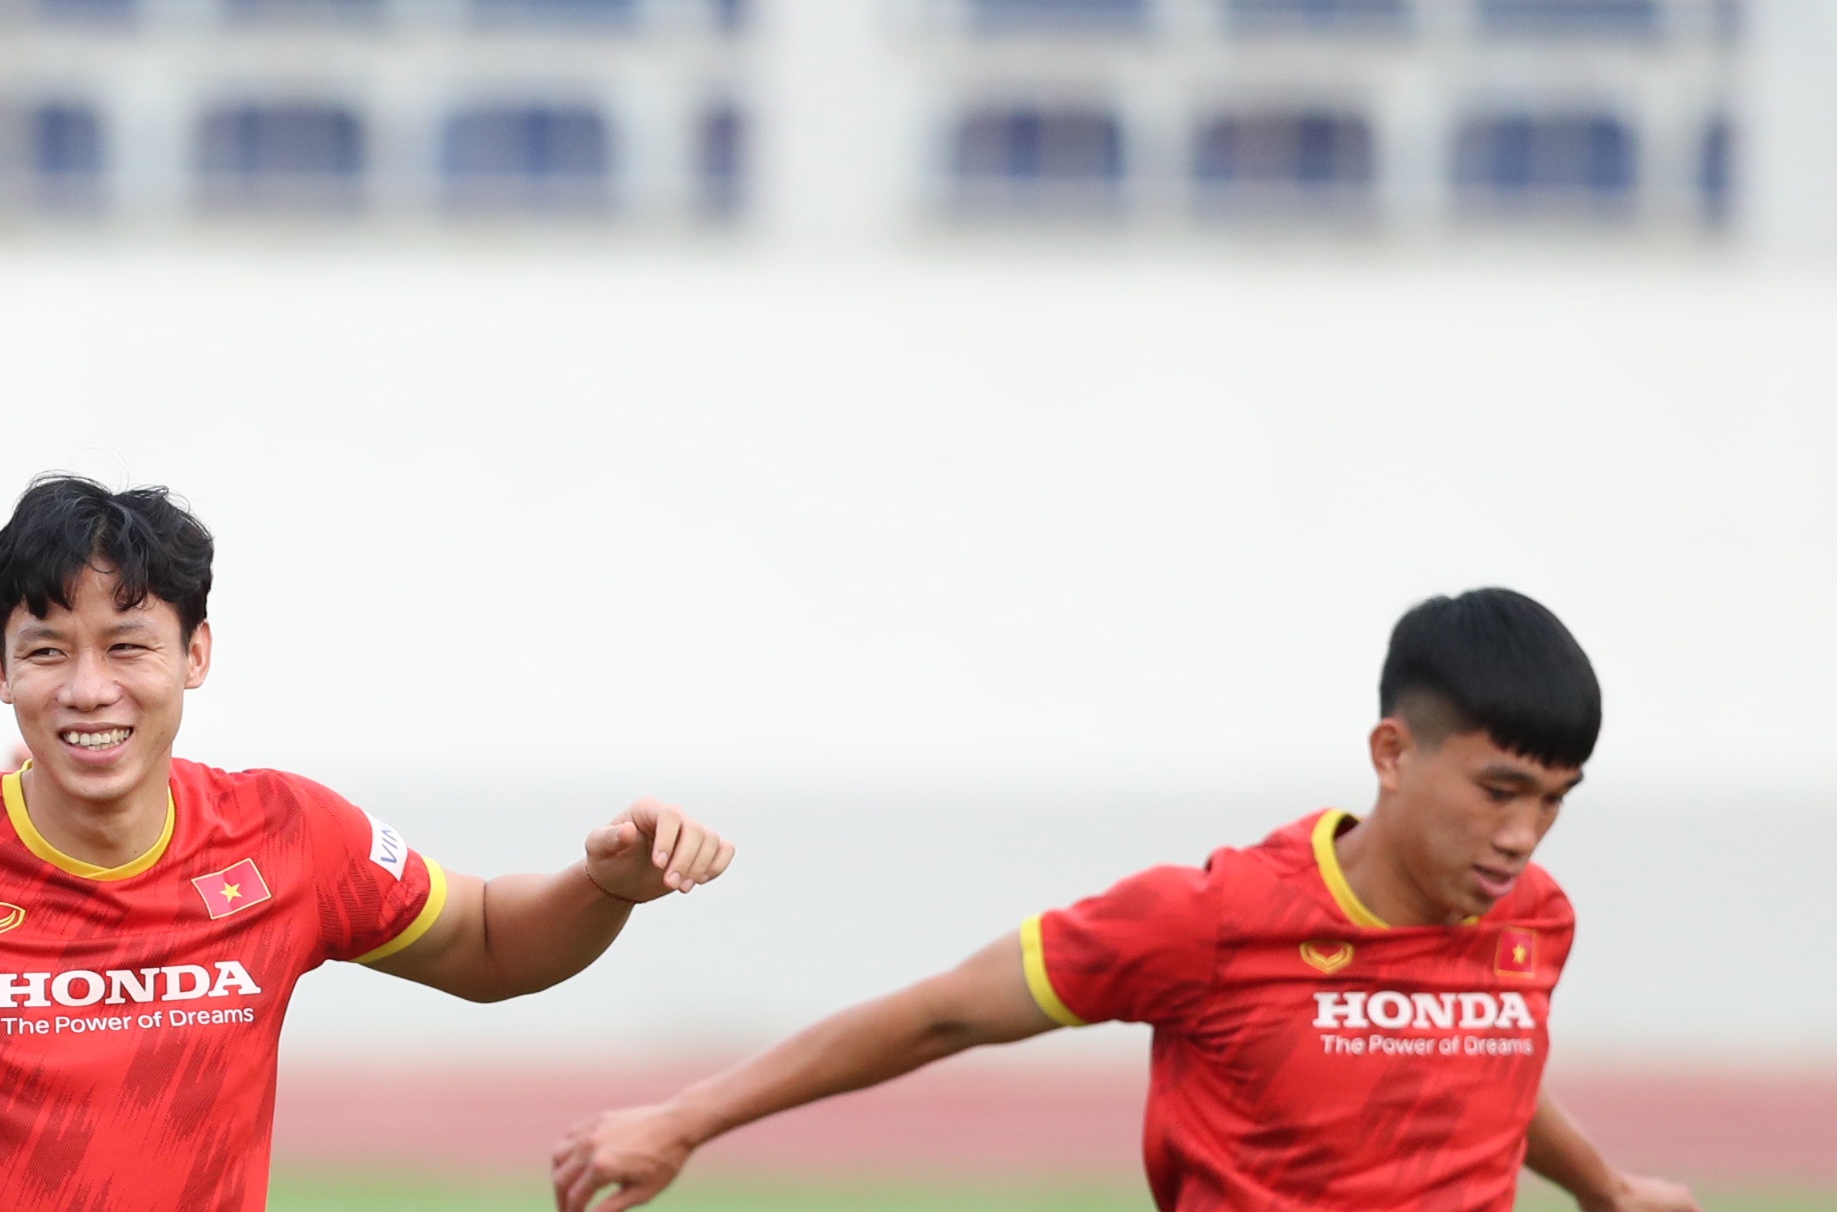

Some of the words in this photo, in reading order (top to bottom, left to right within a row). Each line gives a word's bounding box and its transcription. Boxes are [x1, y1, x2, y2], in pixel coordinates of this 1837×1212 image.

[1, 1017, 50, 1036] The
[55, 1015, 132, 1034] Power
[137, 1010, 163, 1029] of
[169, 1006, 254, 1027] Dreams
[1312, 990, 1535, 1030] HONDA
[1319, 1034, 1367, 1055] The
[1368, 1034, 1436, 1056] Power
[1438, 1034, 1461, 1056] of
[1464, 1034, 1534, 1057] Dreams
